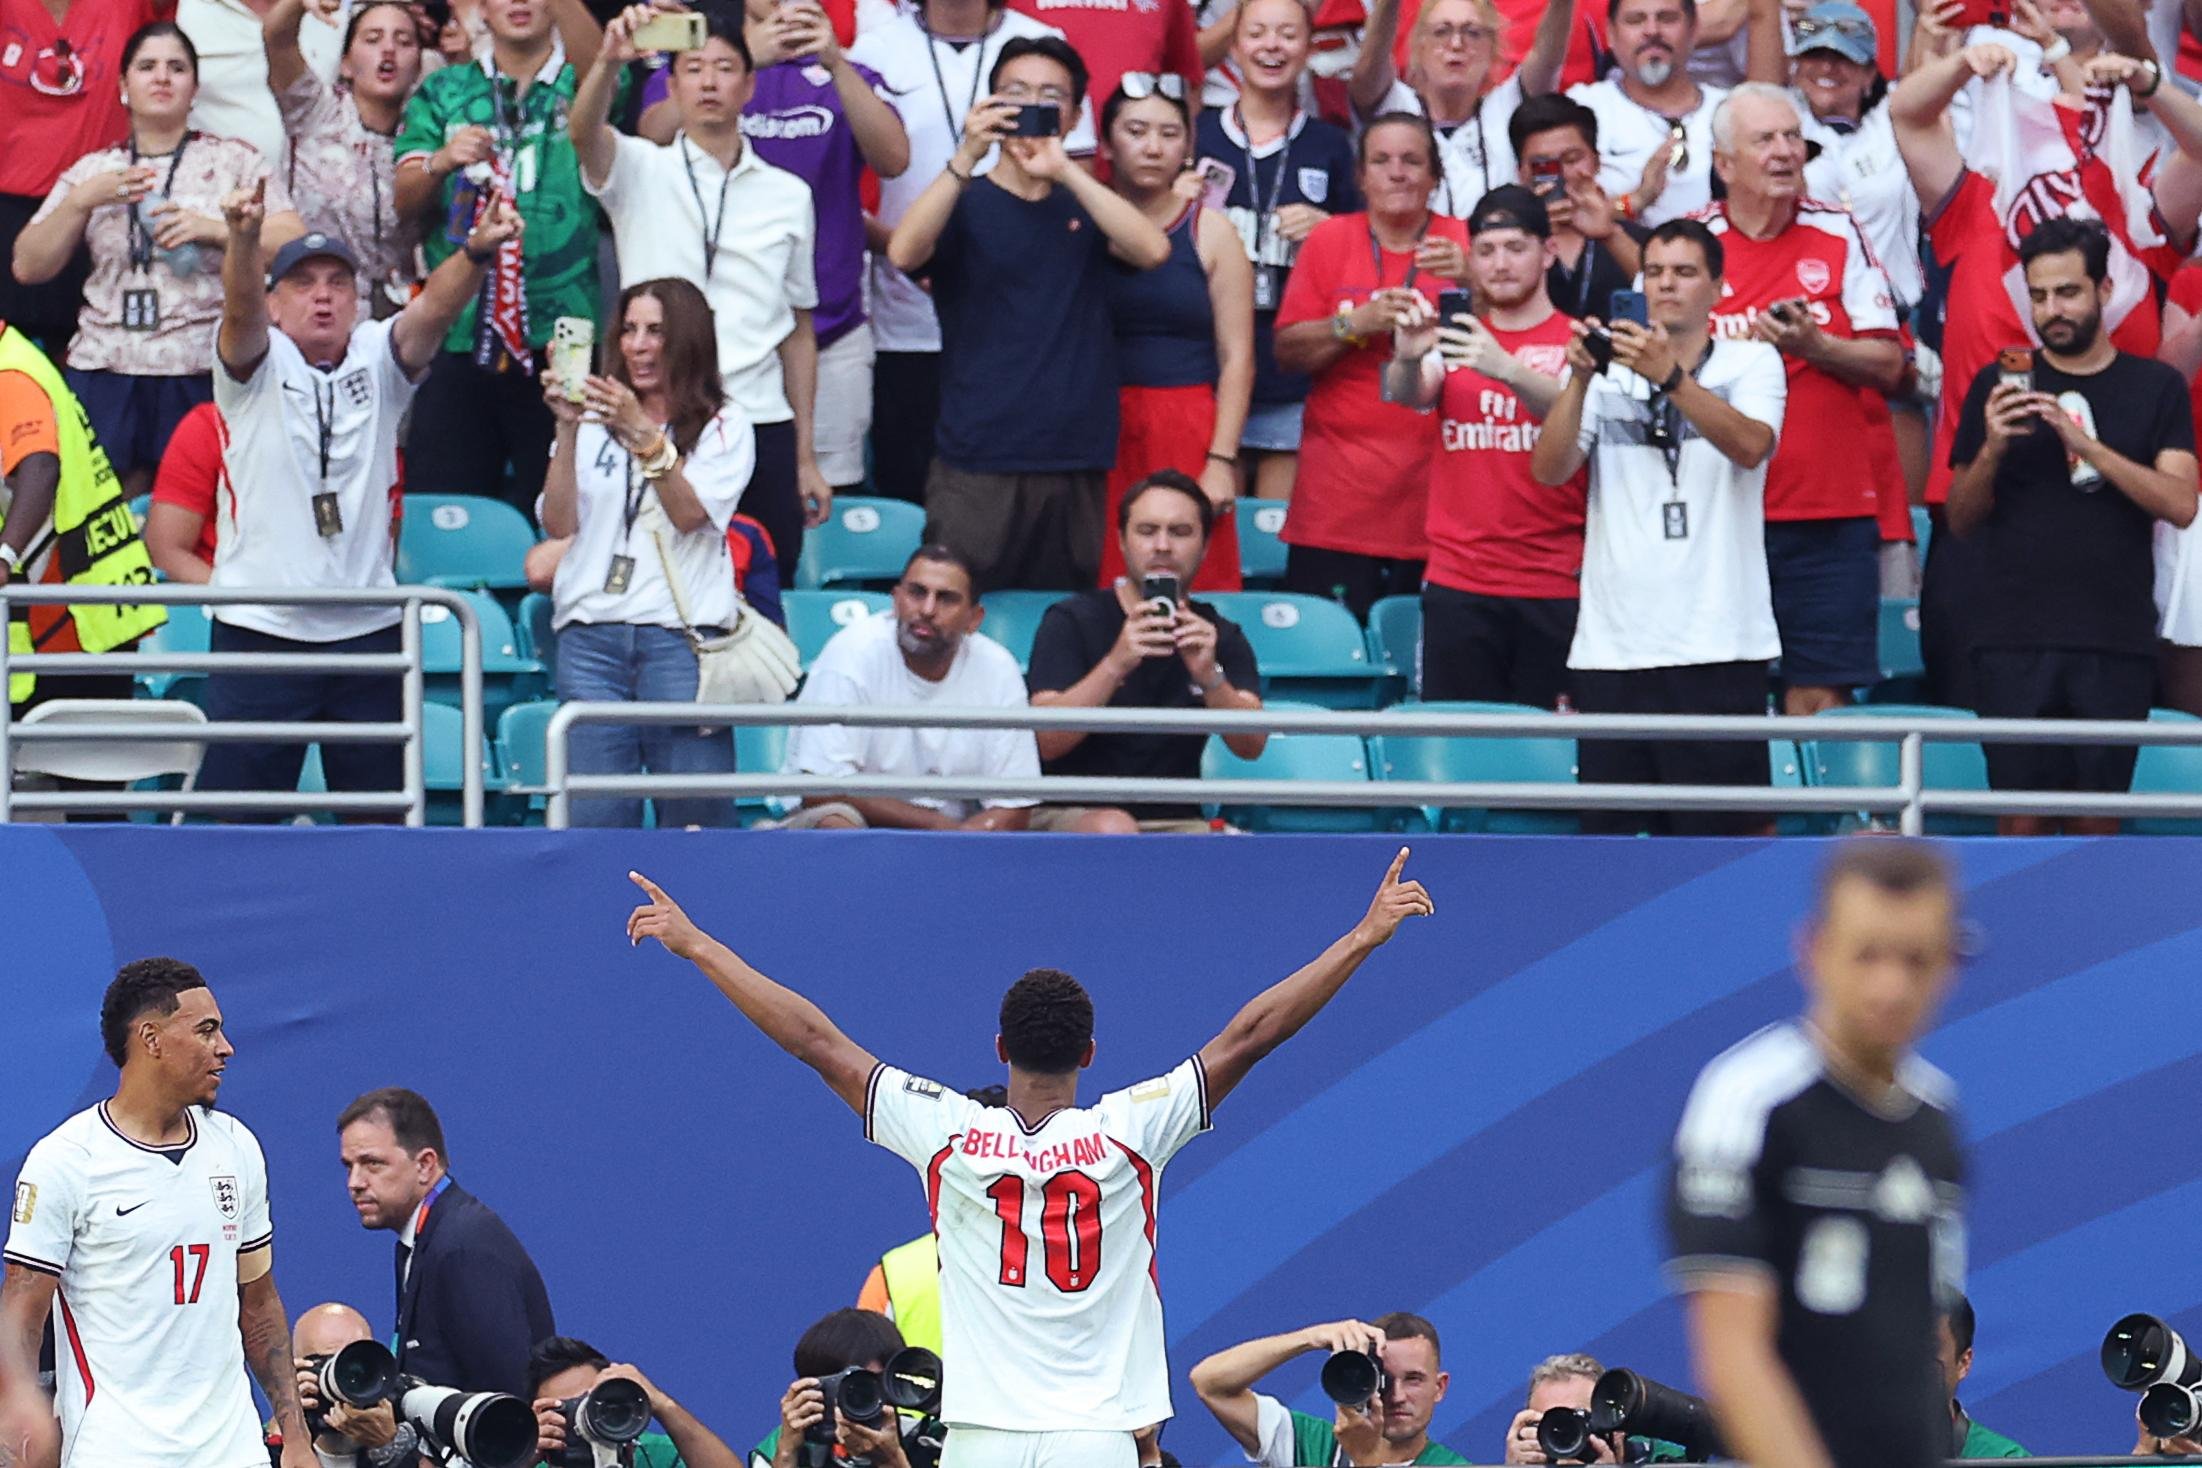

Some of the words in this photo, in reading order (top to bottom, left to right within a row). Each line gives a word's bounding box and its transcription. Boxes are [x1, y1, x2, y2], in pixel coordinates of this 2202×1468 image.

[1442, 416, 1541, 452] Emirat
[594, 436, 616, 478] 4
[962, 1128, 1107, 1173] BELLNGHAM
[986, 1169, 1103, 1293] 10
[170, 1243, 210, 1305] 17
